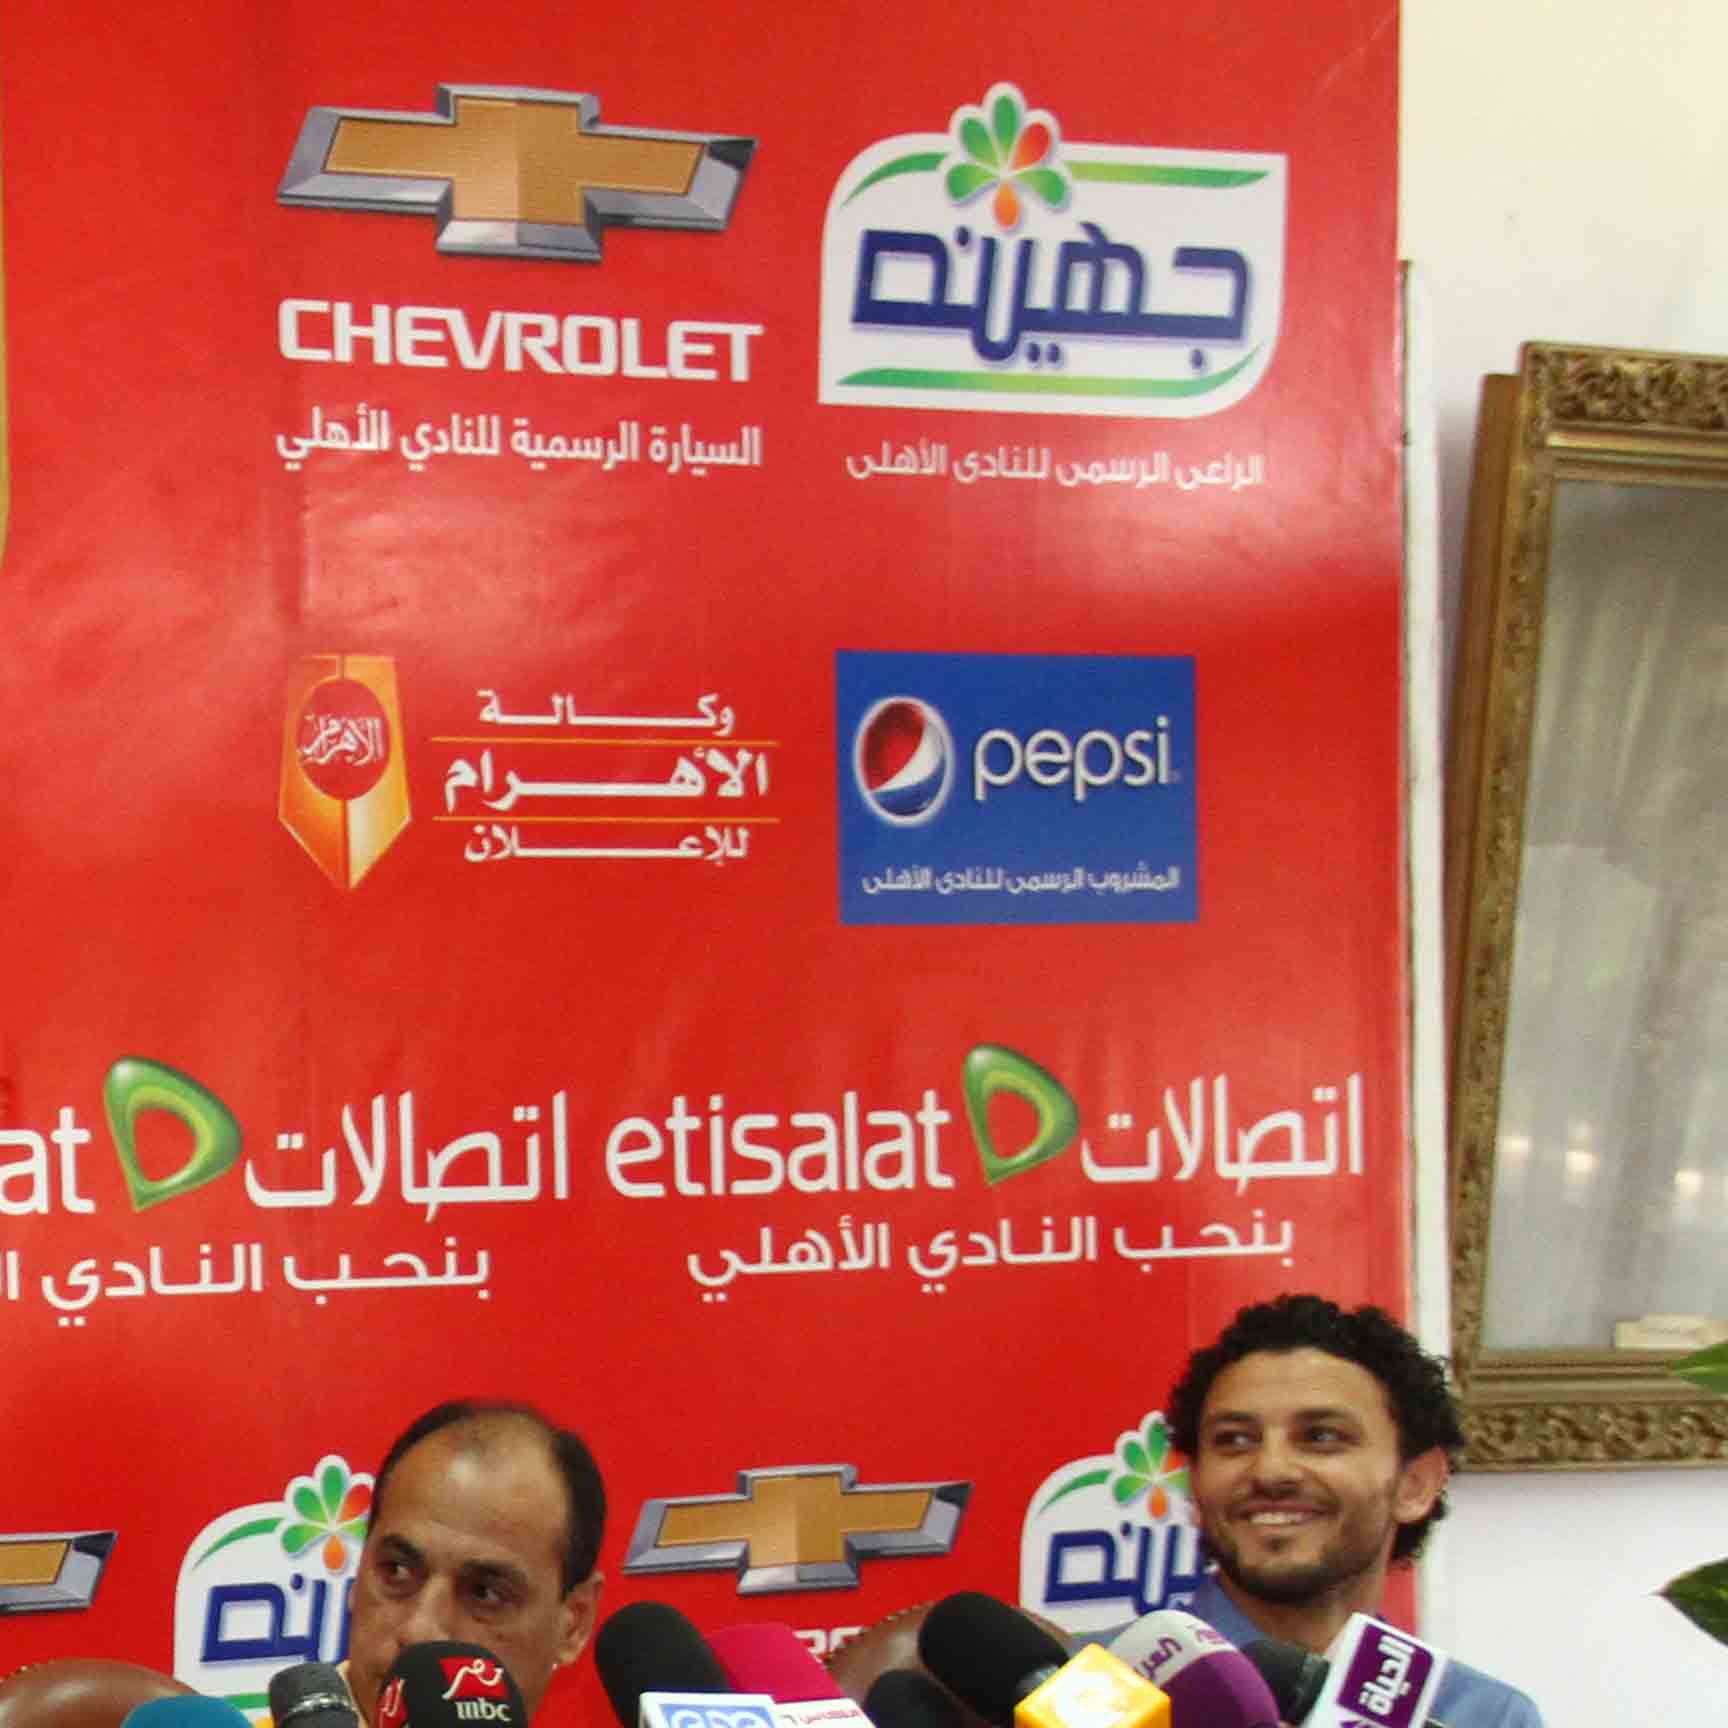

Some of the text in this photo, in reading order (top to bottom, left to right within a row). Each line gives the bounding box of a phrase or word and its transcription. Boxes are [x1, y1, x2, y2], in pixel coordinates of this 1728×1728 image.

[279, 299, 763, 381] CHEVROLET
[277, 403, 761, 473] السيارة الرسمية للنادي الأهلي
[477, 689, 734, 736] وكالة
[975, 716, 1168, 801] pepsi
[245, 1092, 568, 1221] اتصالات
[606, 1090, 954, 1197] etisalat
[1082, 1074, 1362, 1194] اتصالات
[42, 1244, 262, 1326] النادي
[283, 1237, 489, 1304] بنحب
[688, 1209, 1294, 1302] بنحب النادي الأهلي
[454, 1698, 512, 1722] mbc
